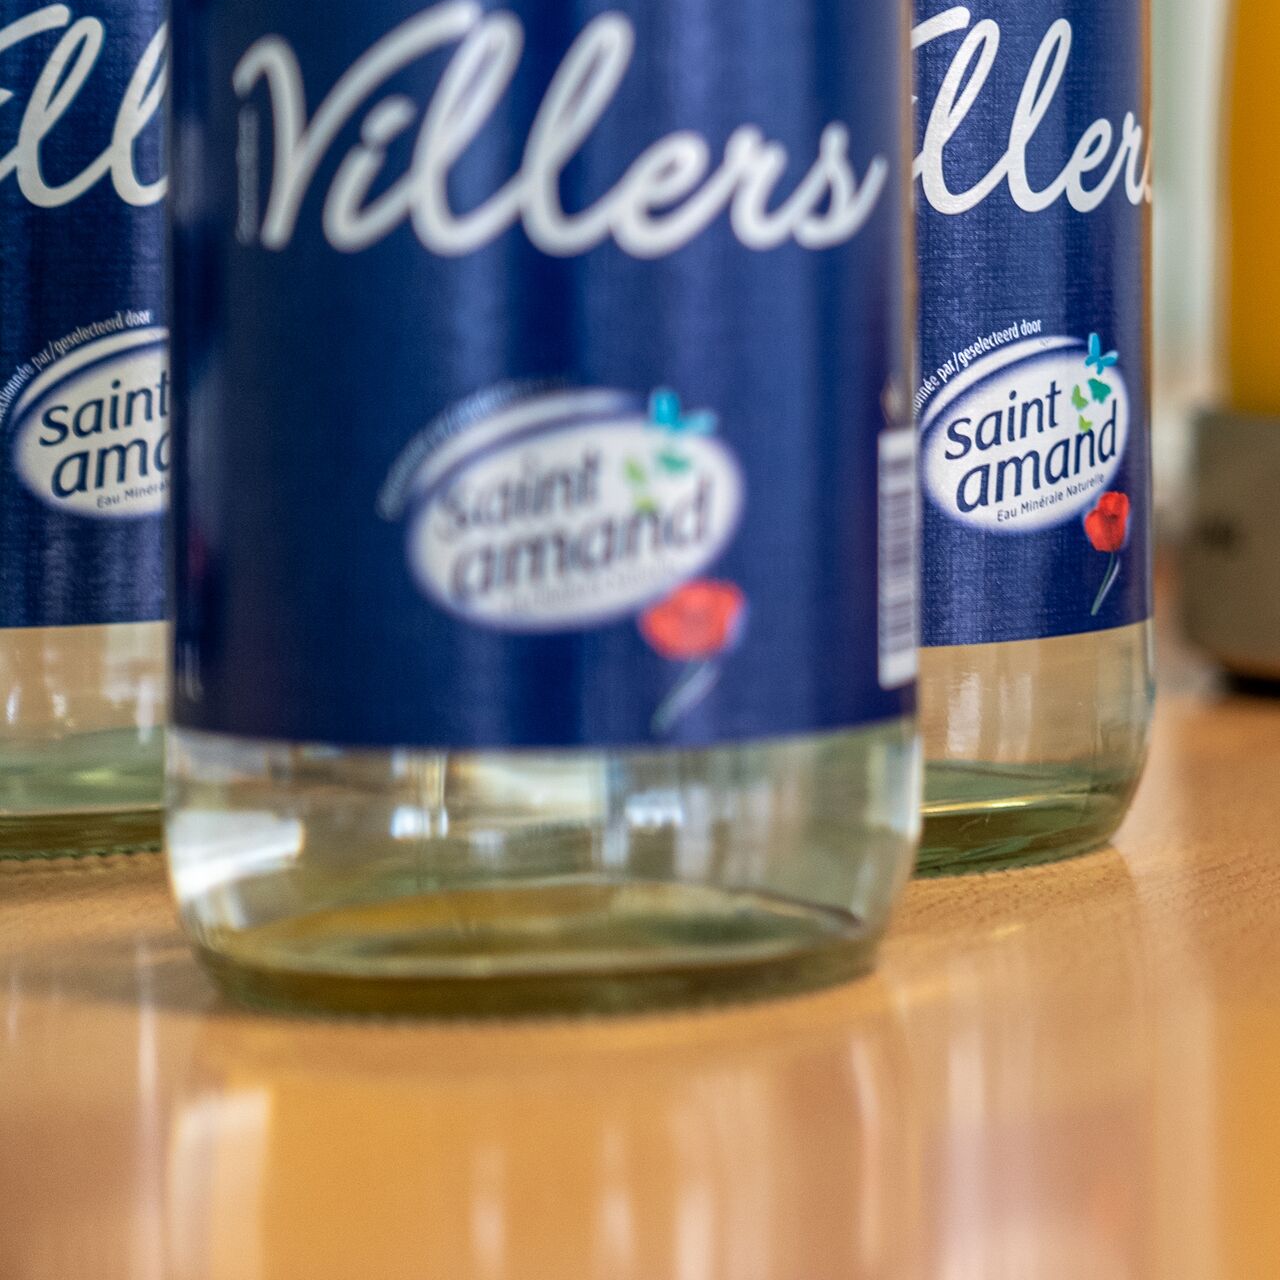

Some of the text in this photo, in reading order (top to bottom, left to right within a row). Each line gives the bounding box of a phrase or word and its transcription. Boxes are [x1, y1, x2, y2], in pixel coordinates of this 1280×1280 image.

[911, 5, 1152, 214] ller
[1020, 318, 1042, 336] door
[944, 380, 1062, 460] saint
[956, 398, 1117, 513] amand
[996, 507, 1018, 522] Eau
[1020, 490, 1065, 515] Minérale
